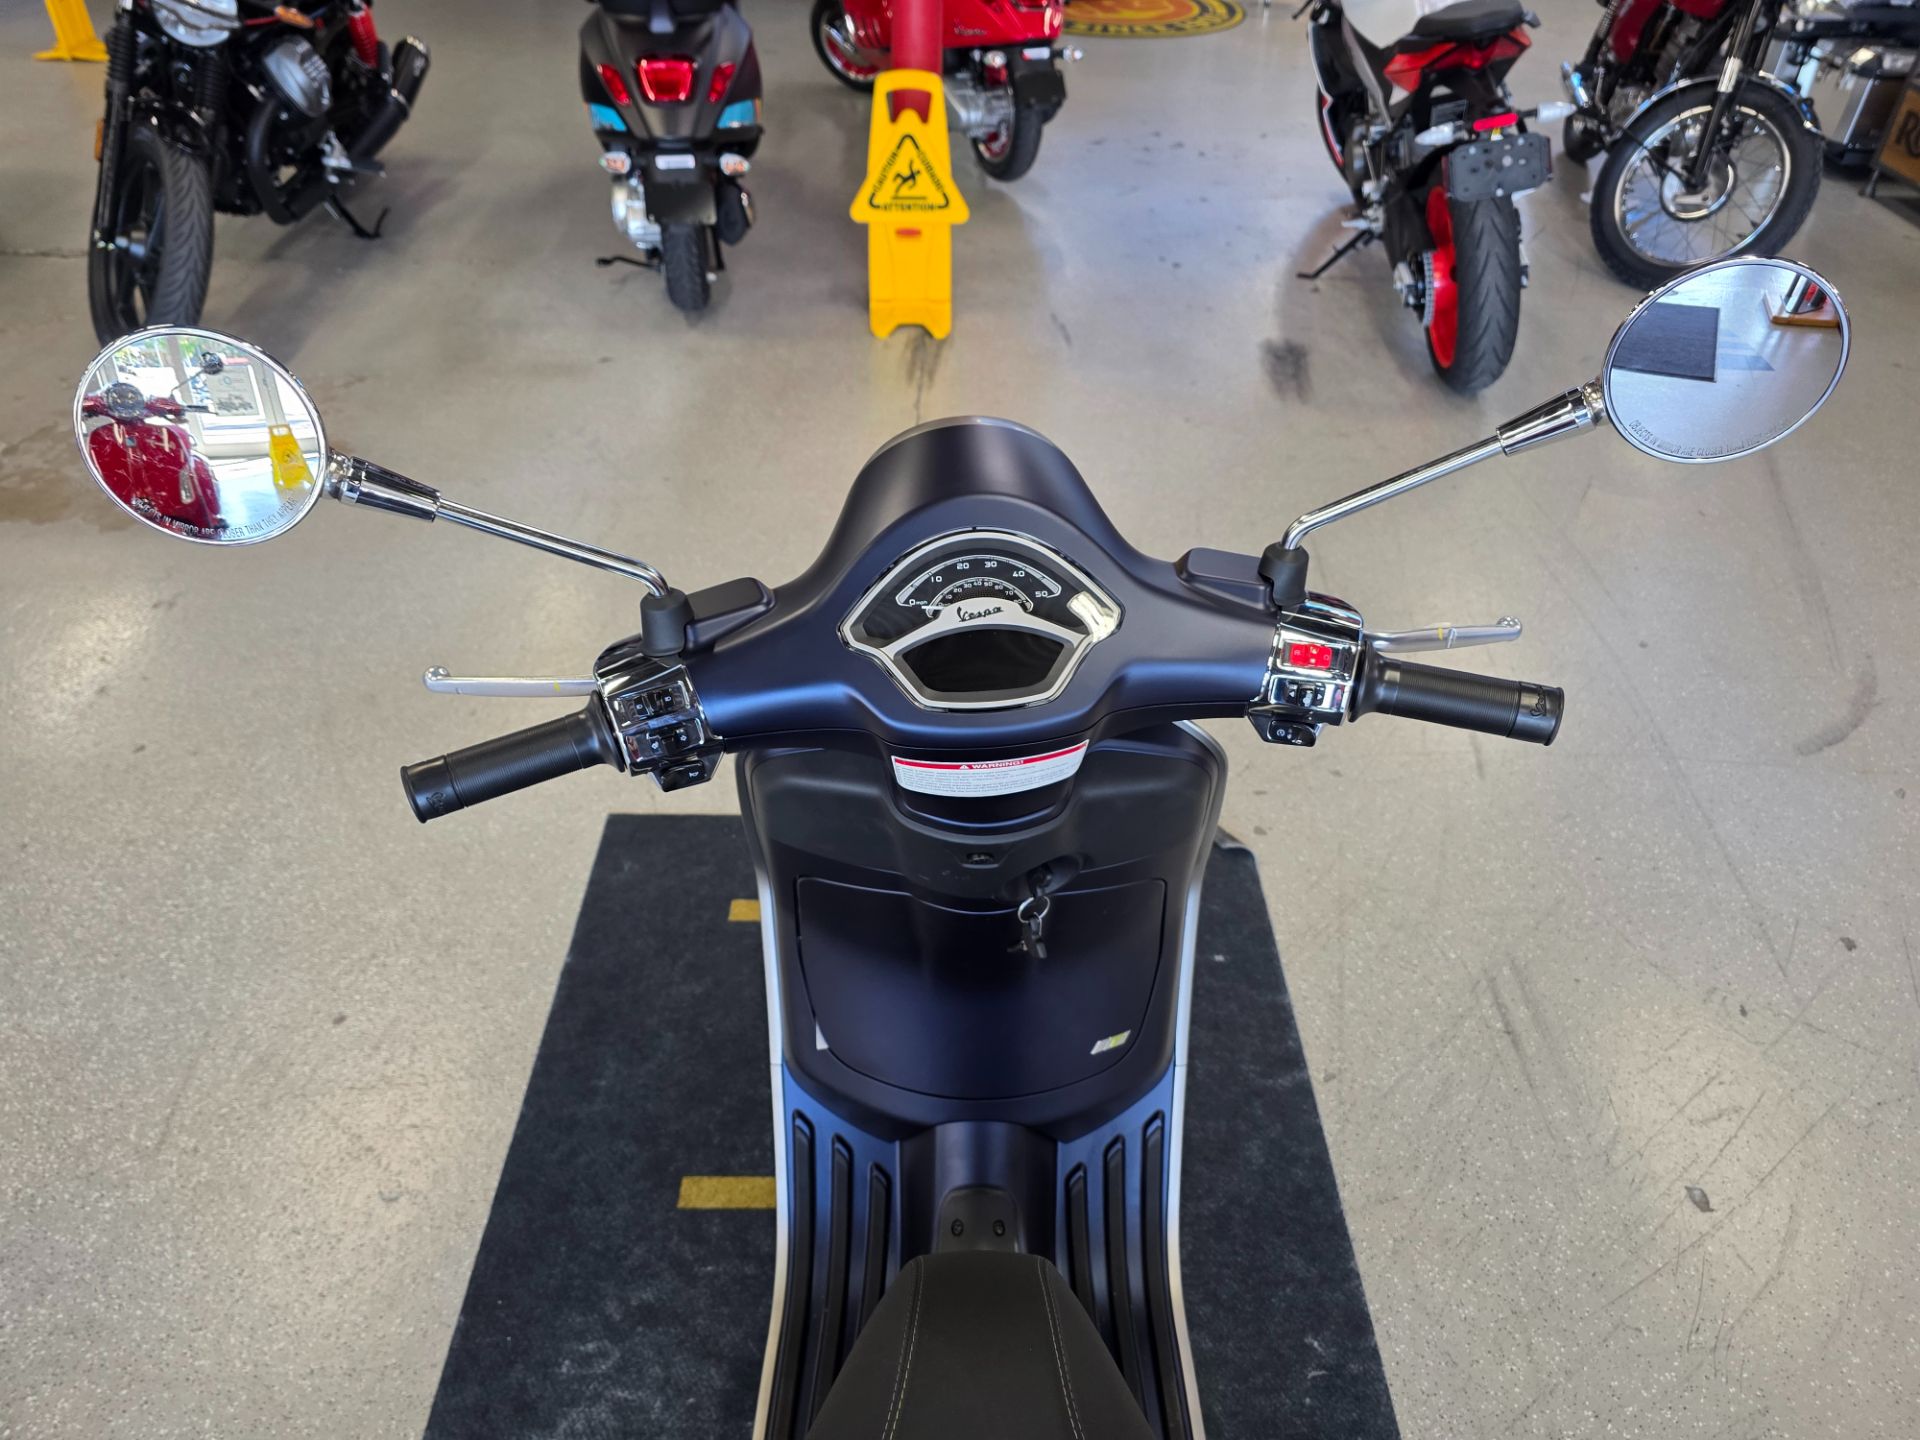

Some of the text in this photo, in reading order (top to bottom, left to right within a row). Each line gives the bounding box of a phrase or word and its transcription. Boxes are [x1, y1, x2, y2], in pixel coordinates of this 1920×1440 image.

[244, 521, 263, 535] THAN
[930, 575, 942, 583] 10
[956, 562, 970, 570] 20
[1012, 570, 1025, 578] 40
[1035, 590, 1048, 598] 50
[957, 606, 1004, 623] Vespa
[971, 759, 1025, 770] WARNING!
